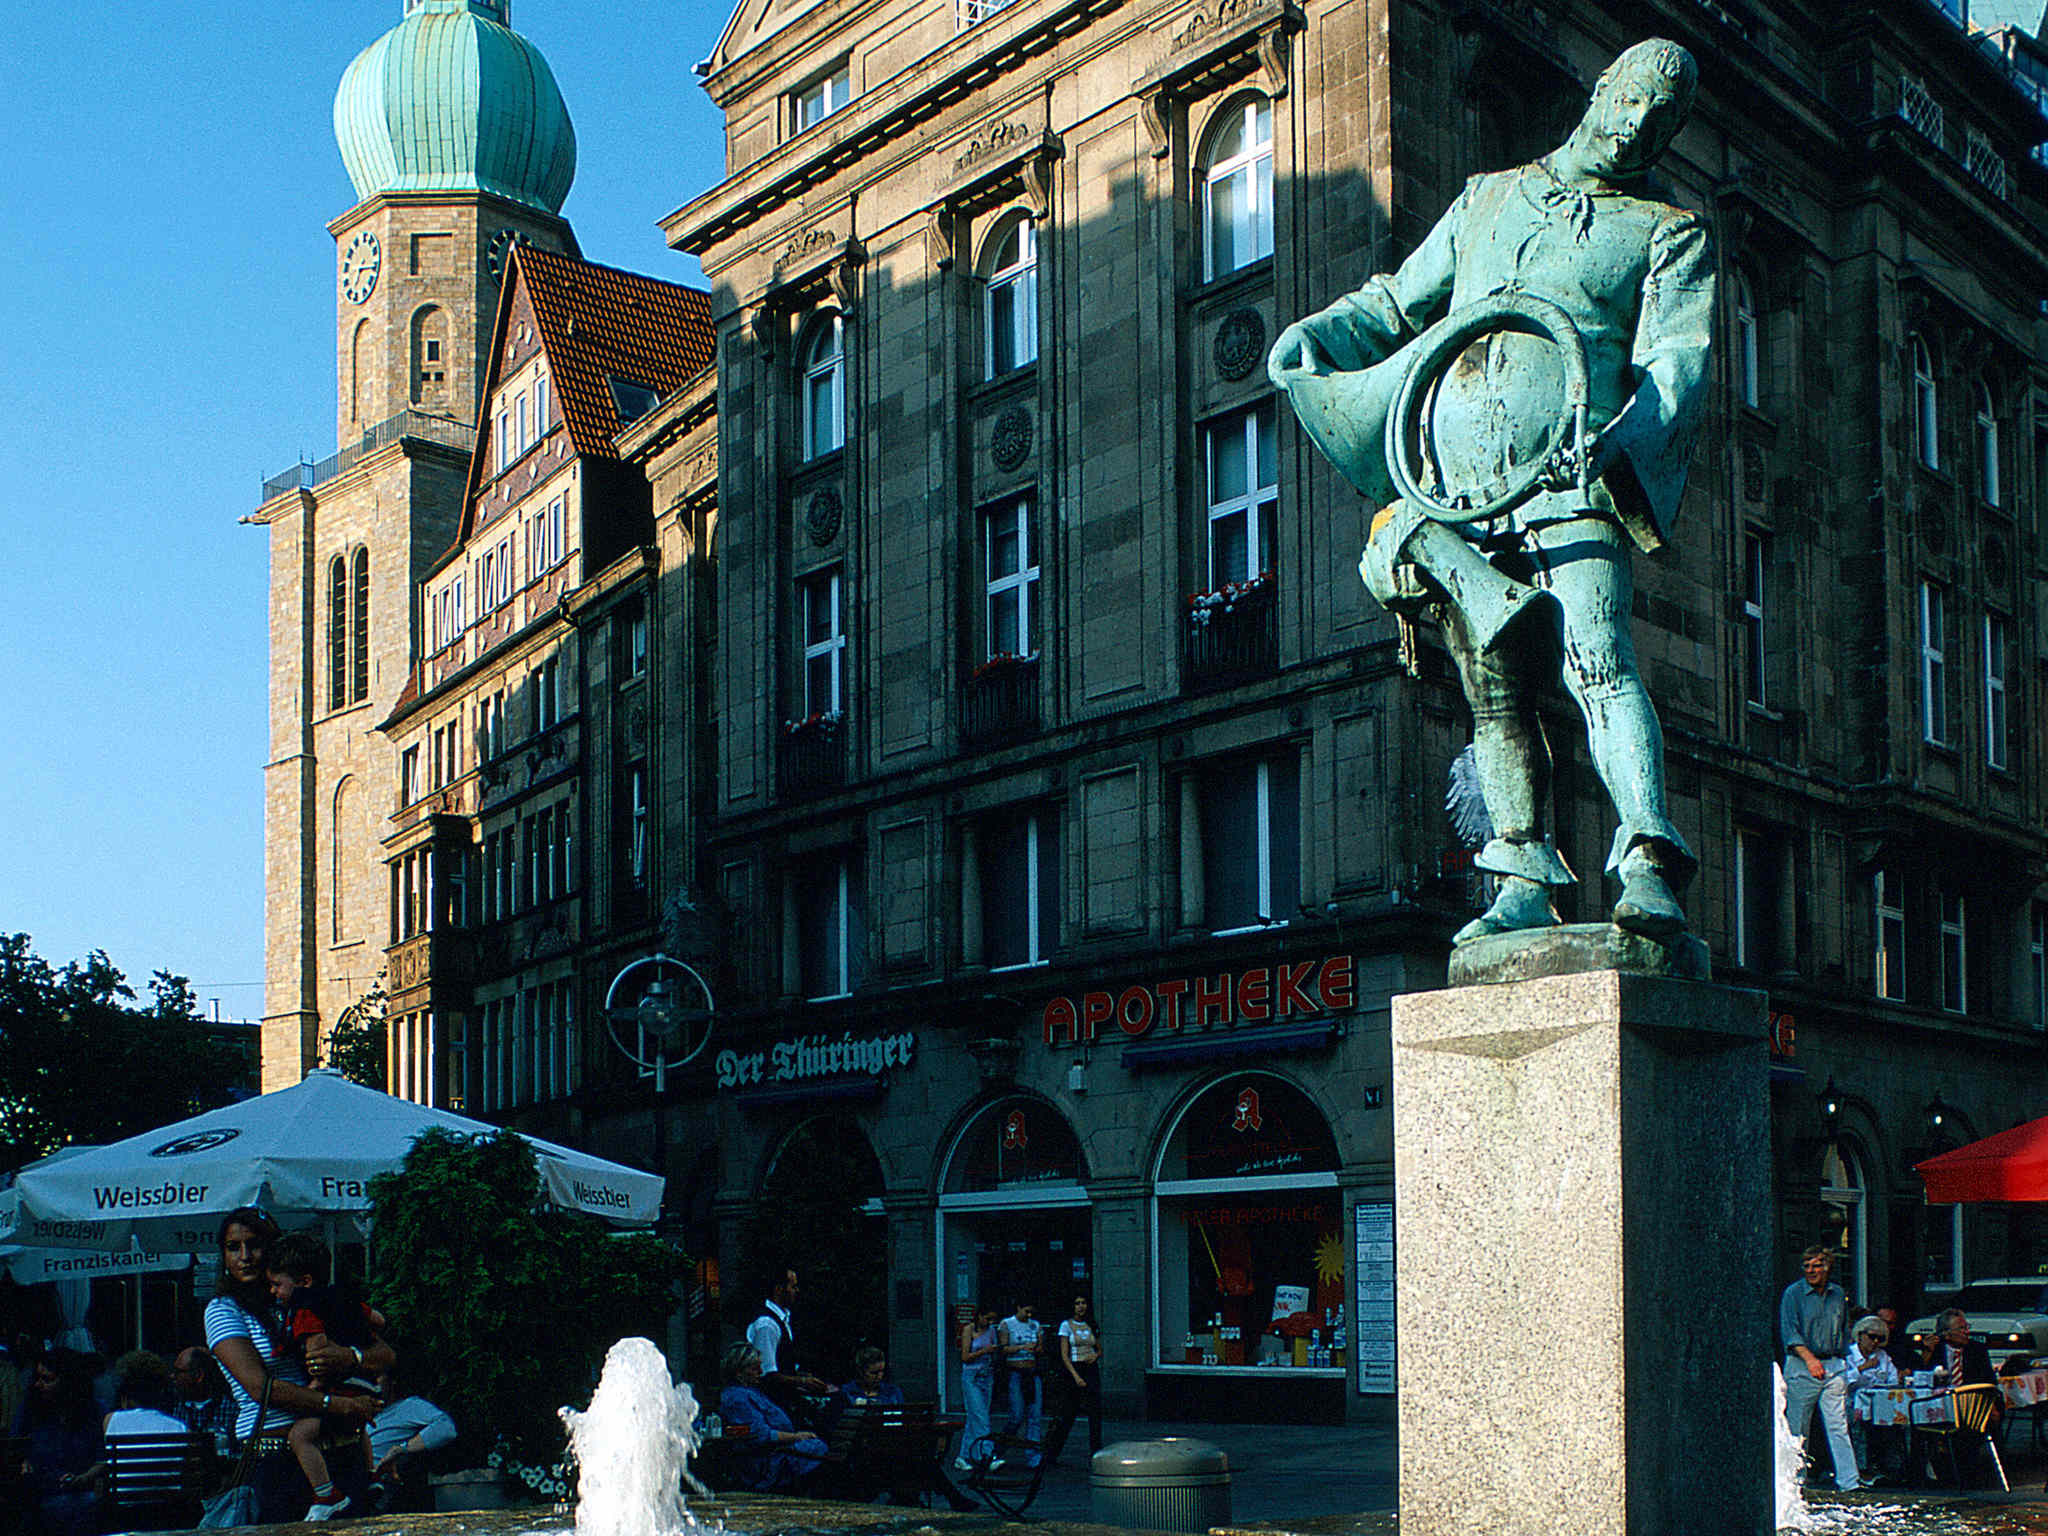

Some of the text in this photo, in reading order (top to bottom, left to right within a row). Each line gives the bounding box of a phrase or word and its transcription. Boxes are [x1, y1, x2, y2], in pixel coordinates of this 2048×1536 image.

[1043, 955, 1355, 1045] APOTHEKE
[715, 1031, 915, 1088] Der Thüringer
[93, 1181, 209, 1210] Weissbier
[573, 1181, 632, 1209] Weissbier
[44, 1251, 161, 1273] Franziskaner
